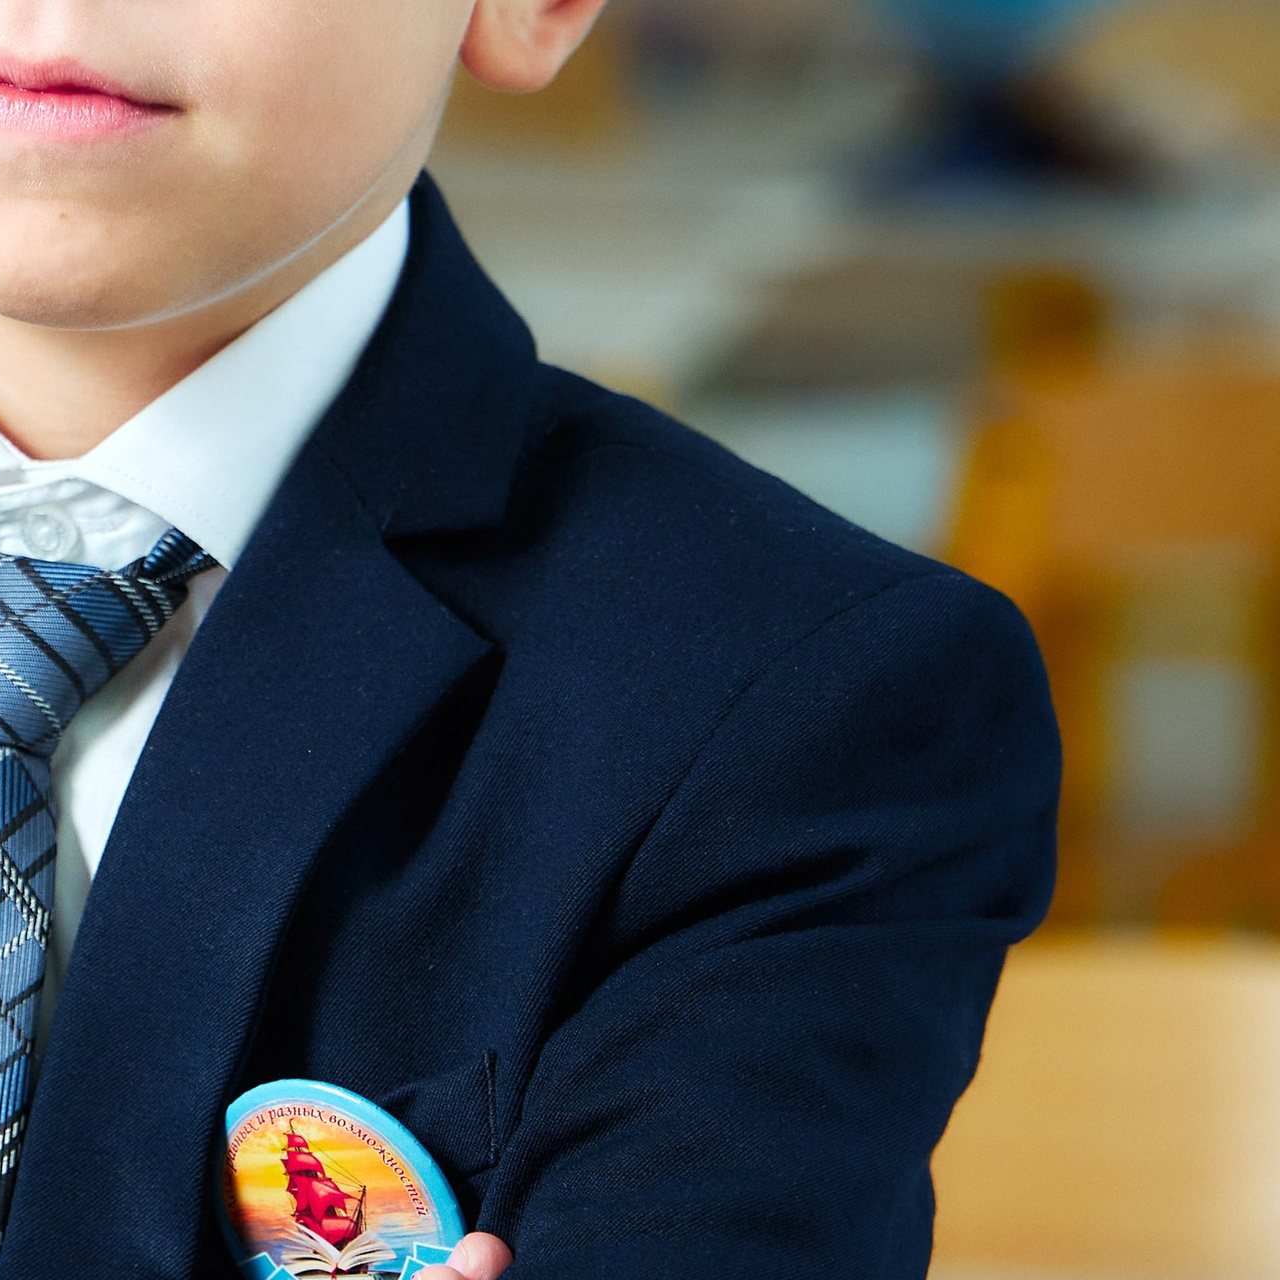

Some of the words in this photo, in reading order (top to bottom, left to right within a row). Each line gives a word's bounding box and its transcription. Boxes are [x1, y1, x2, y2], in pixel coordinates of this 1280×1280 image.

[257, 1113, 267, 1125] и
[268, 1106, 326, 1124] разных
[329, 1114, 430, 1216] возможностей
